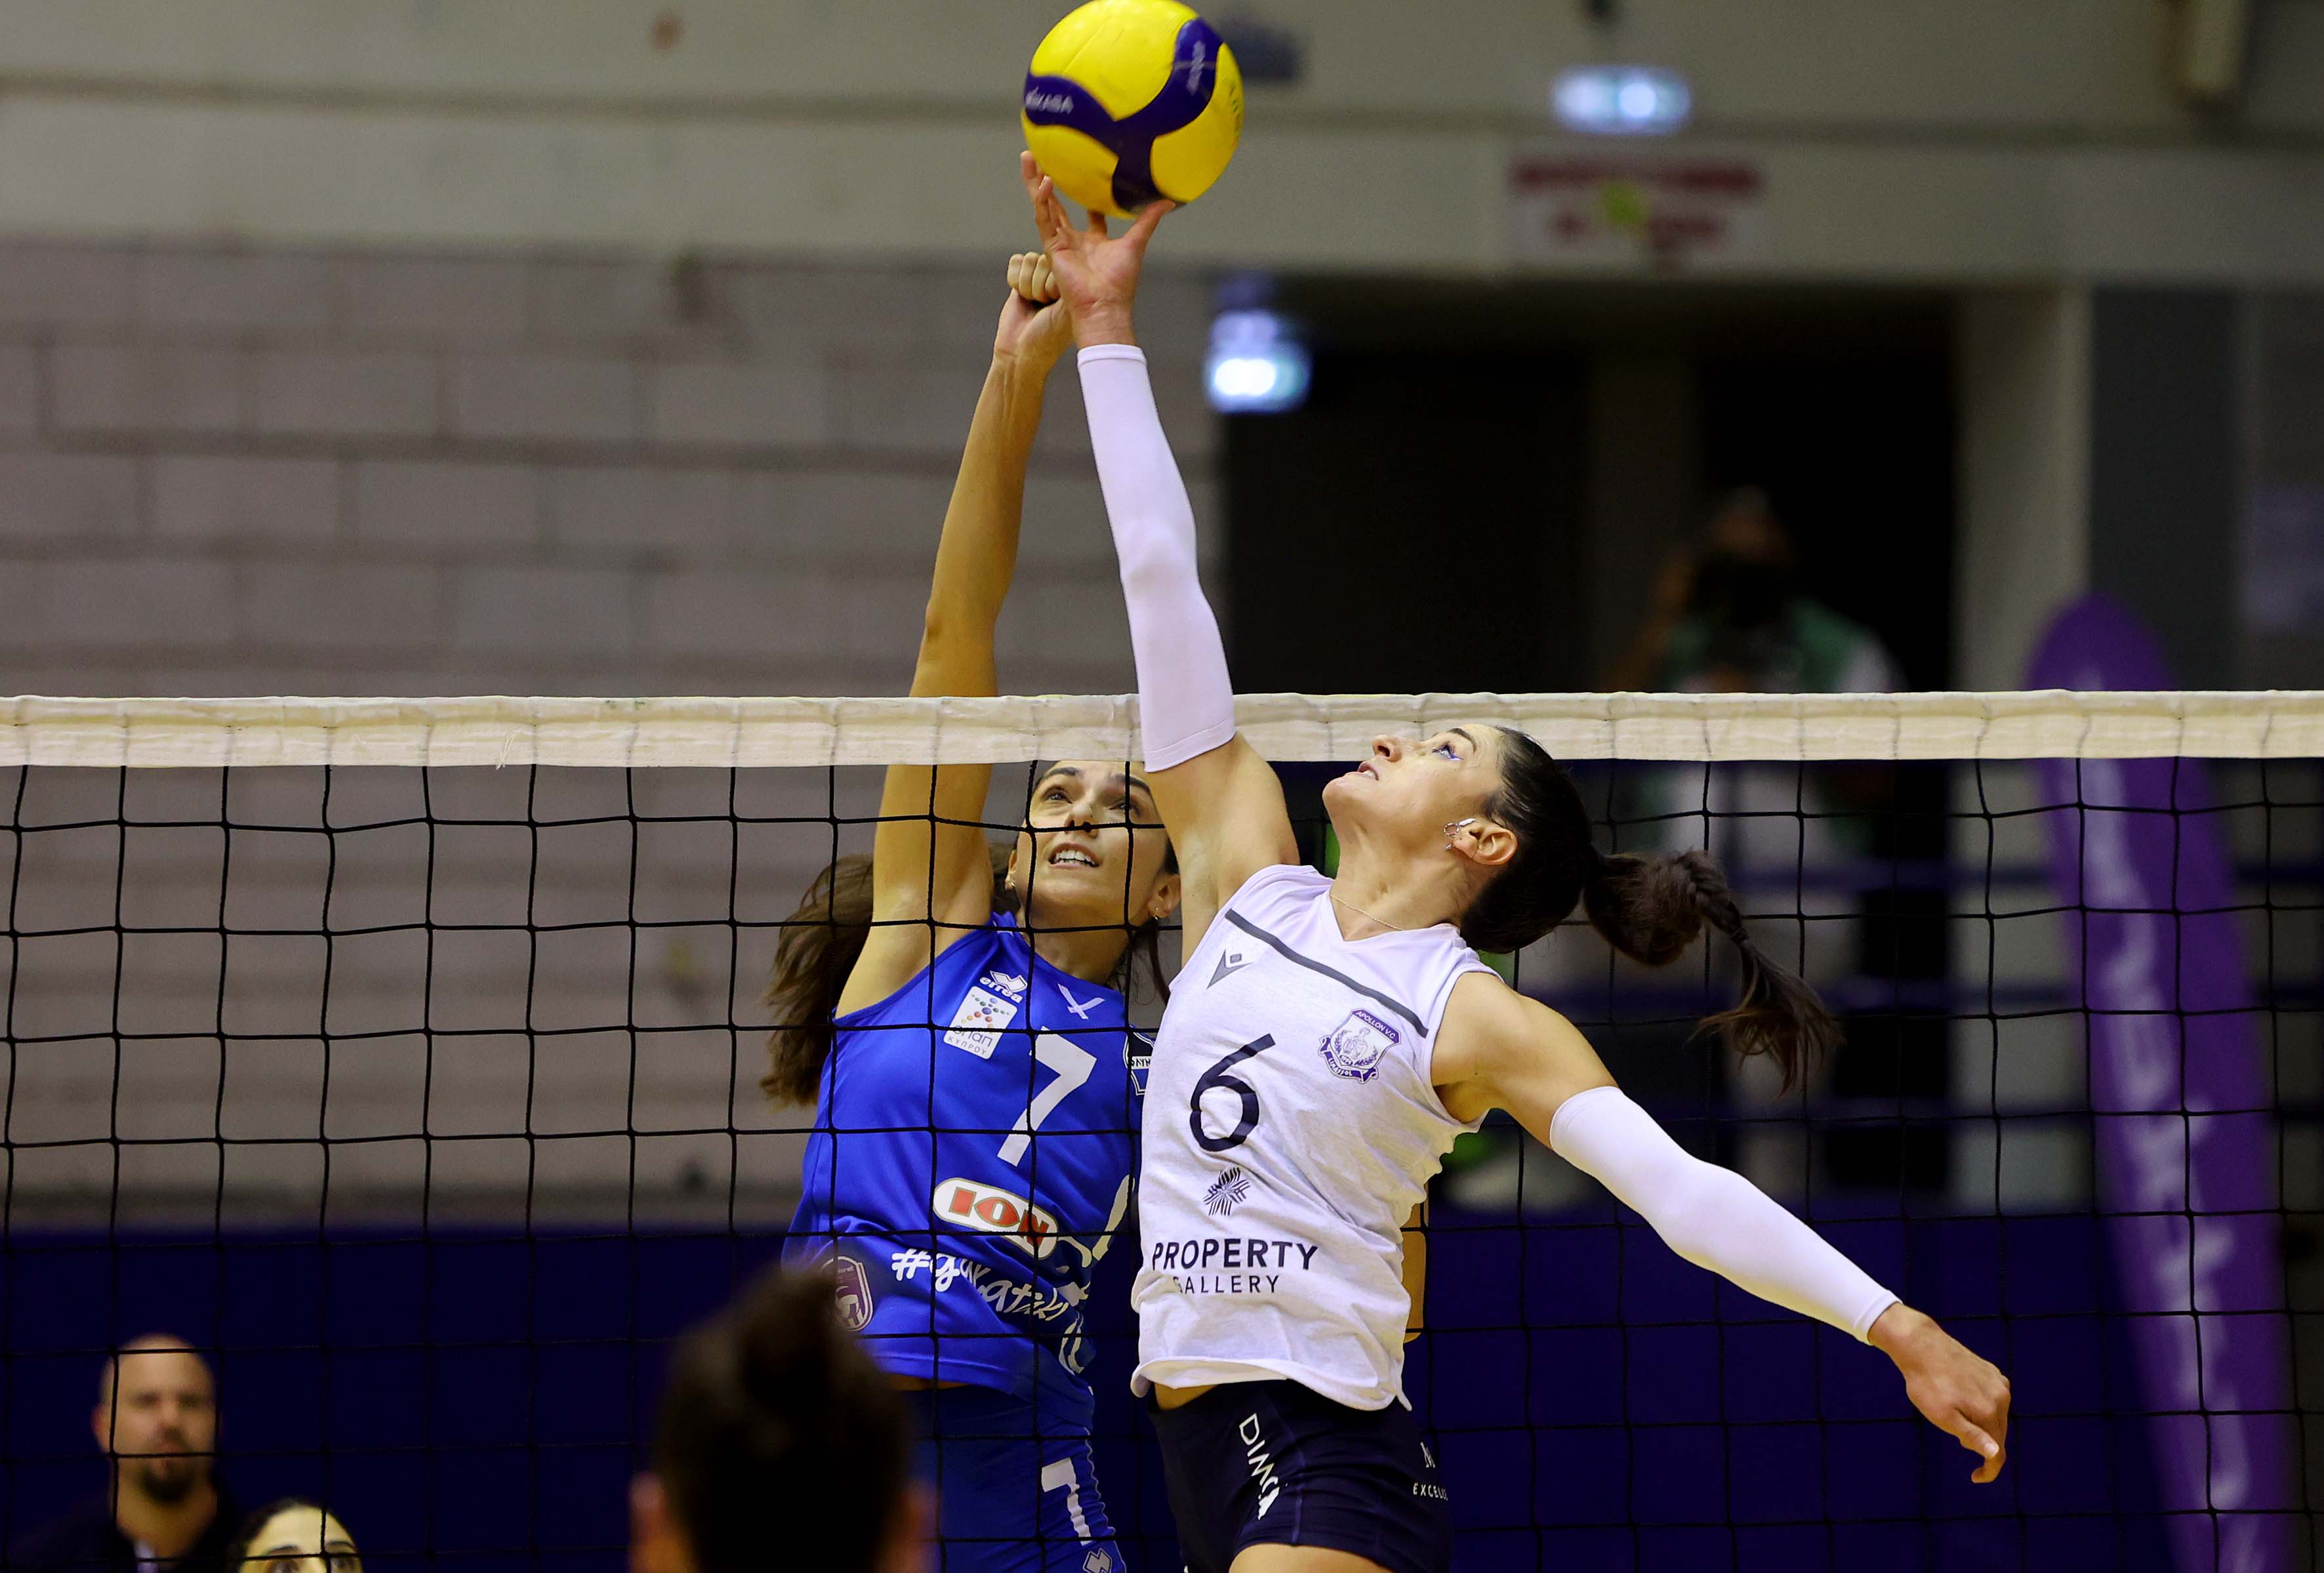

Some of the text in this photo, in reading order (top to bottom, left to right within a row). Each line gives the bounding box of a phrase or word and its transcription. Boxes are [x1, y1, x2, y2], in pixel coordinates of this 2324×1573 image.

[1356, 1011, 1386, 1032] APOLLON
[997, 1025, 1097, 1167] 7
[1189, 1033, 1276, 1152] 6
[948, 1187, 1050, 1246] ION
[1152, 1238, 1318, 1271] PROPERTY
[1040, 1457, 1092, 1546] 7
